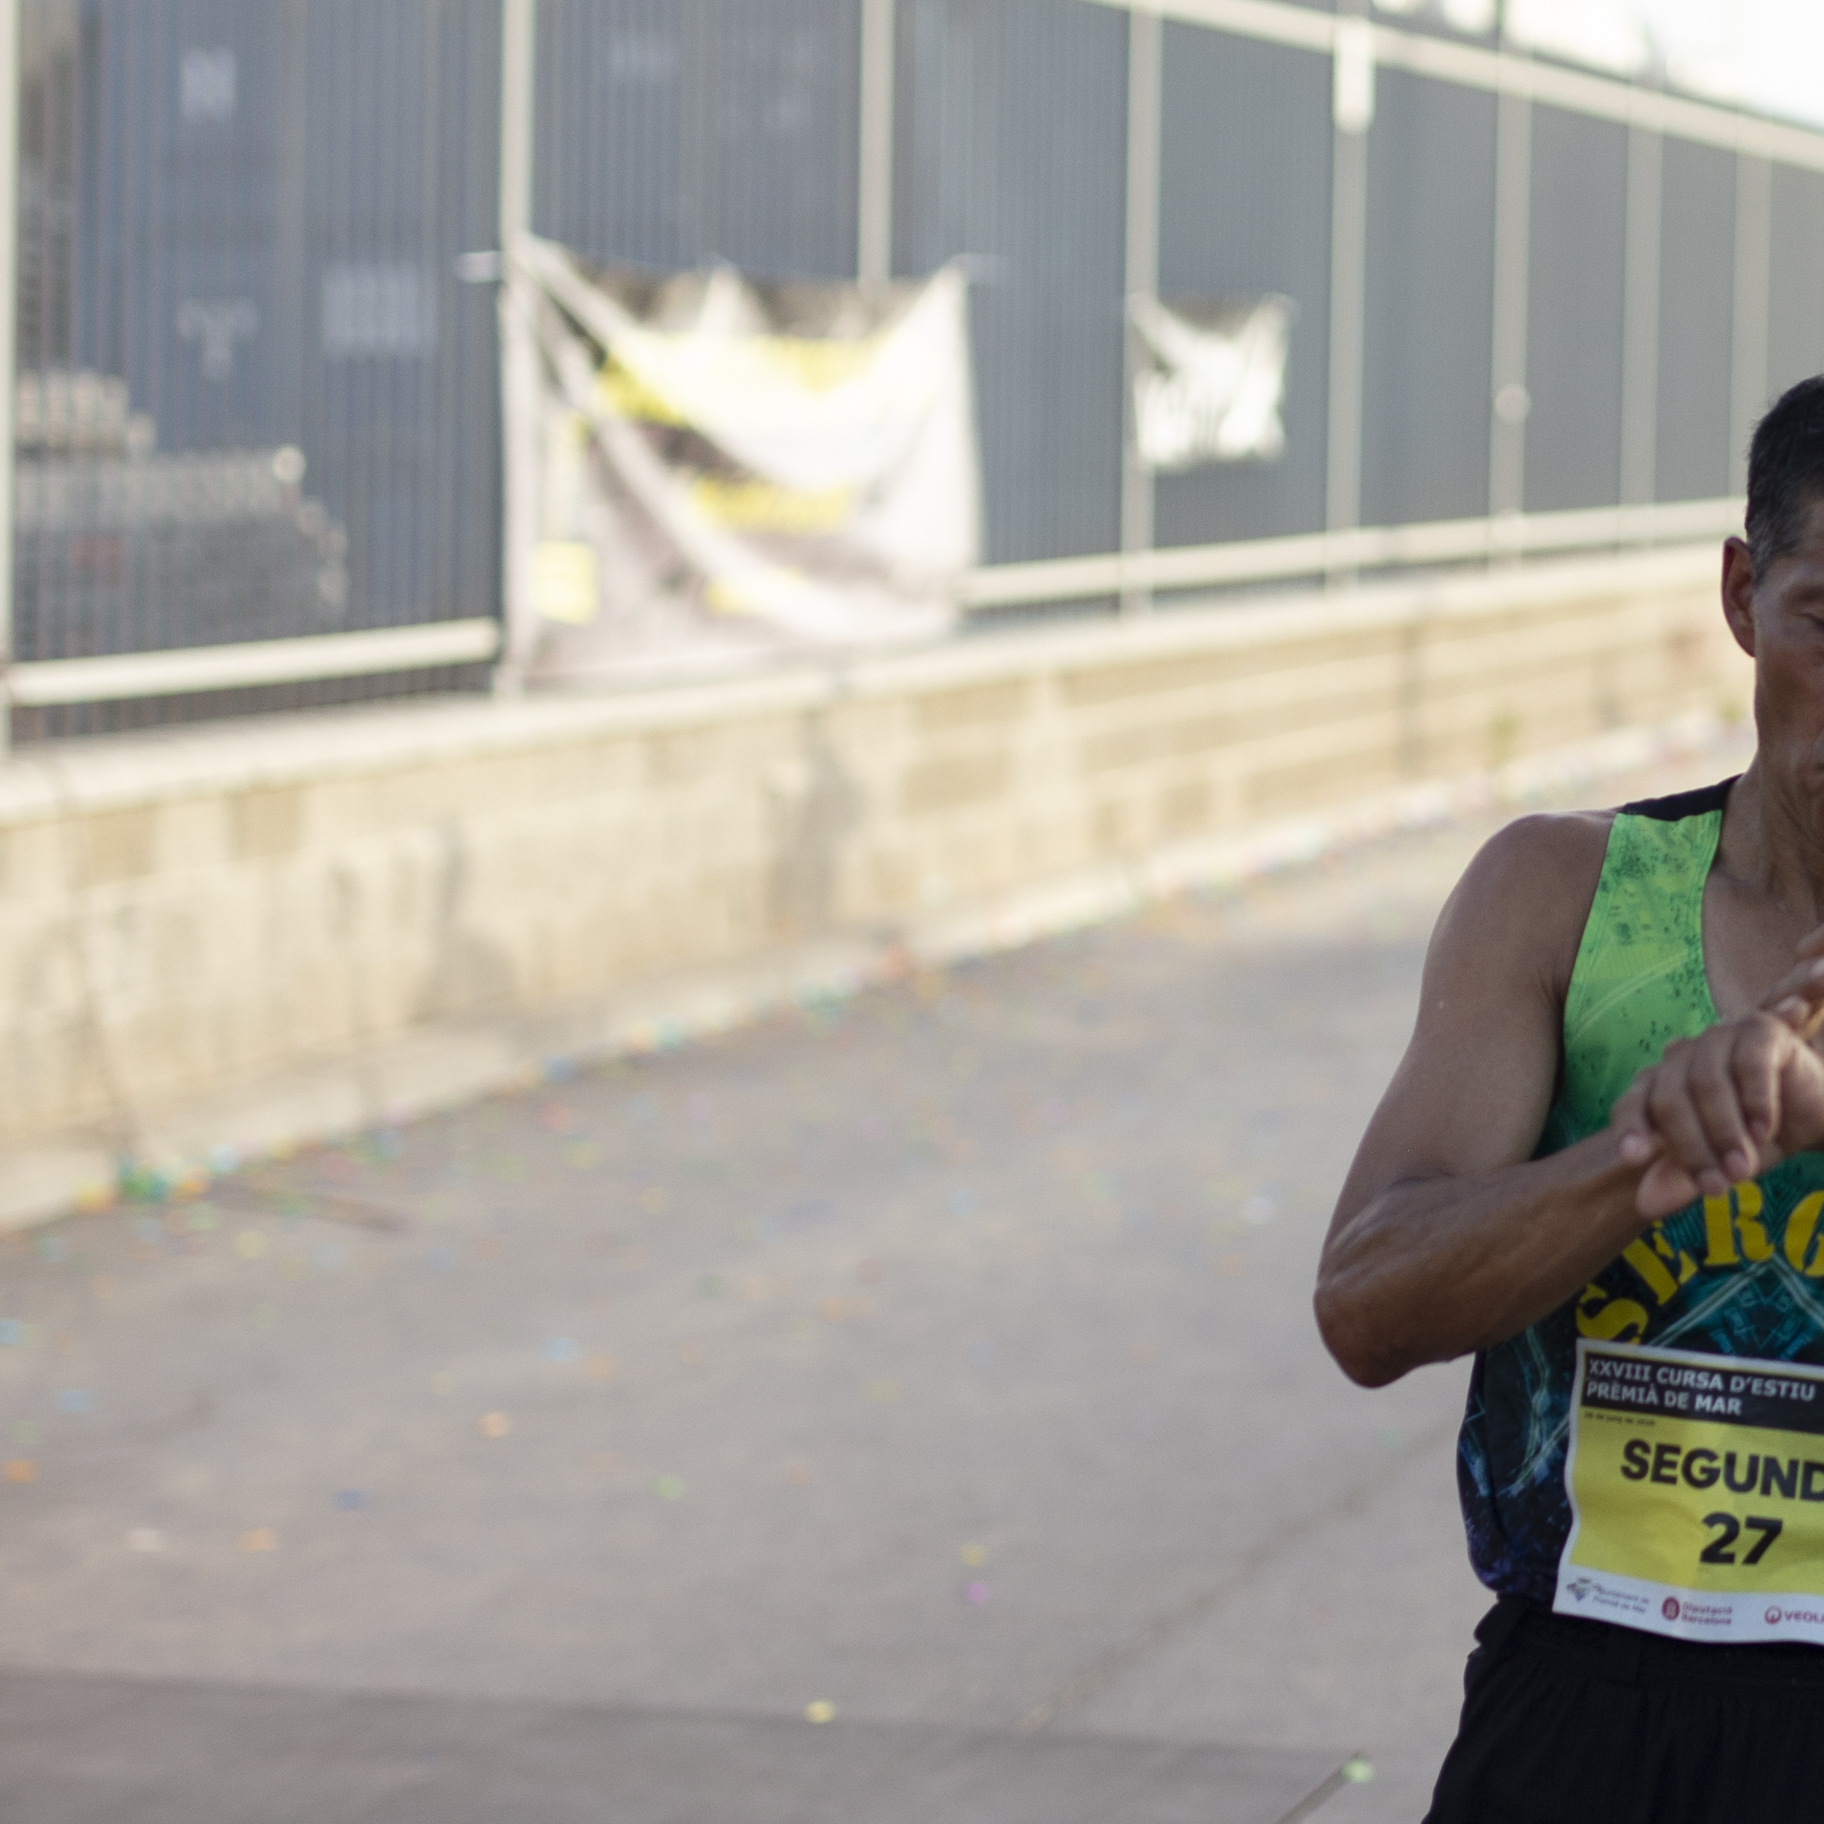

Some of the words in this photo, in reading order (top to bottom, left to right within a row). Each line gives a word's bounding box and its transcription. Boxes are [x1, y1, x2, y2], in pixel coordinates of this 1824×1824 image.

[1589, 1358, 1652, 1381] XXVIII
[1656, 1366, 1724, 1391] CURSA
[1729, 1375, 1816, 1402] D'ESTIU
[1664, 1390, 1690, 1410] DE
[1694, 1395, 1743, 1416] MAR
[1700, 1512, 1783, 1566] 27
